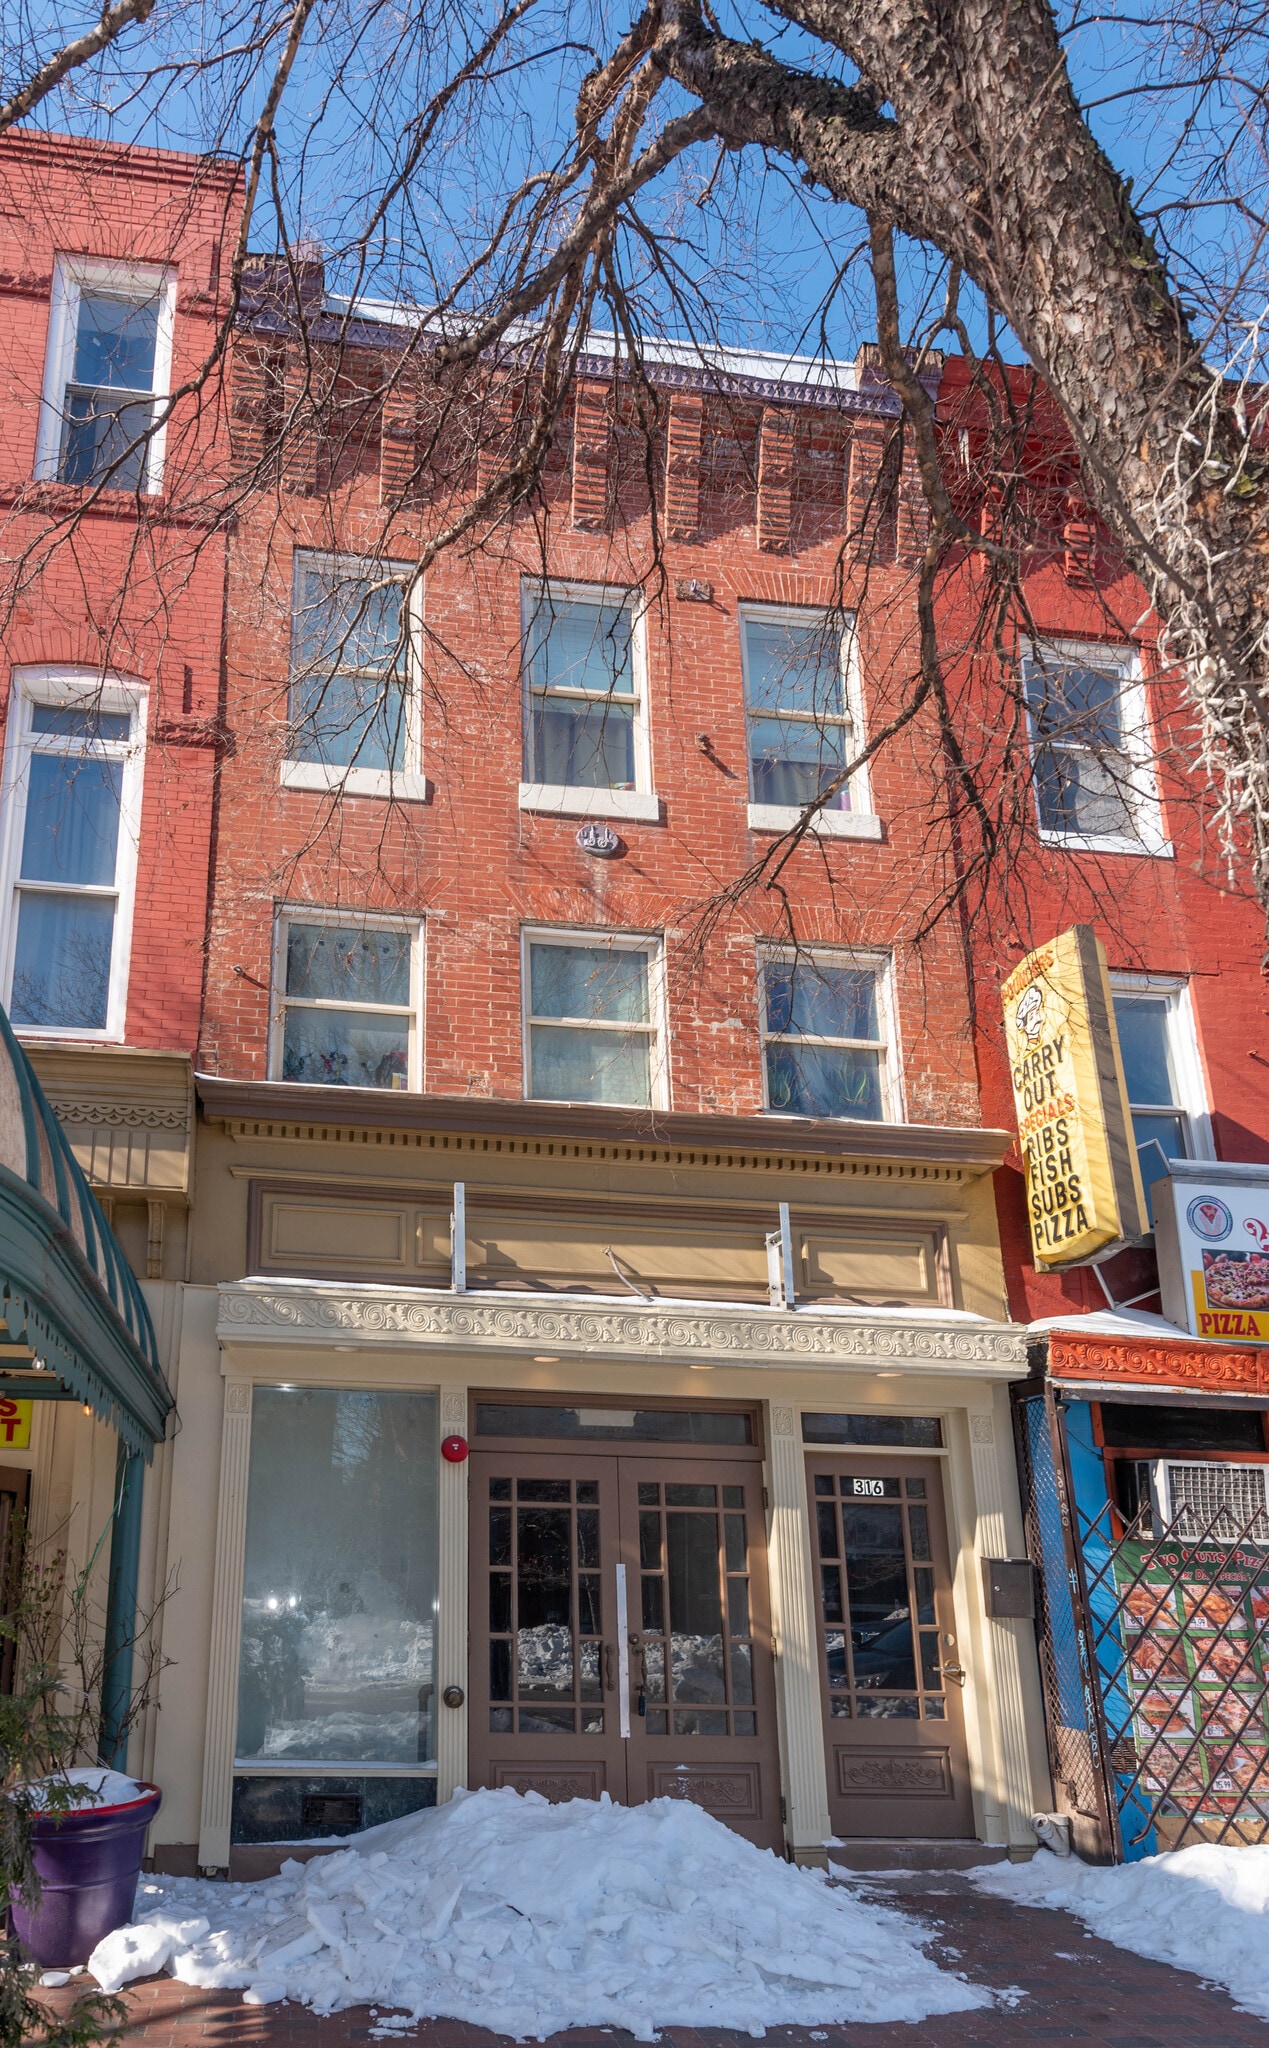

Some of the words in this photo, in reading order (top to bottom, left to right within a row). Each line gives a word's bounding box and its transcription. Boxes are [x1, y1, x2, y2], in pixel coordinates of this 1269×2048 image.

[1013, 1035, 1063, 1092] CARRY
[1024, 1070, 1055, 1112] OUT
[1020, 1093, 1075, 1140] SPECIALS
[1027, 1118, 1069, 1162] RIBS
[1031, 1147, 1073, 1191] FISH
[1032, 1174, 1081, 1221] SUBS
[1034, 1204, 1091, 1250] PIZZA
[1199, 1312, 1261, 1337] PIZZA
[855, 1480, 882, 1495] 316
[1181, 1547, 1227, 1565] GUYS
